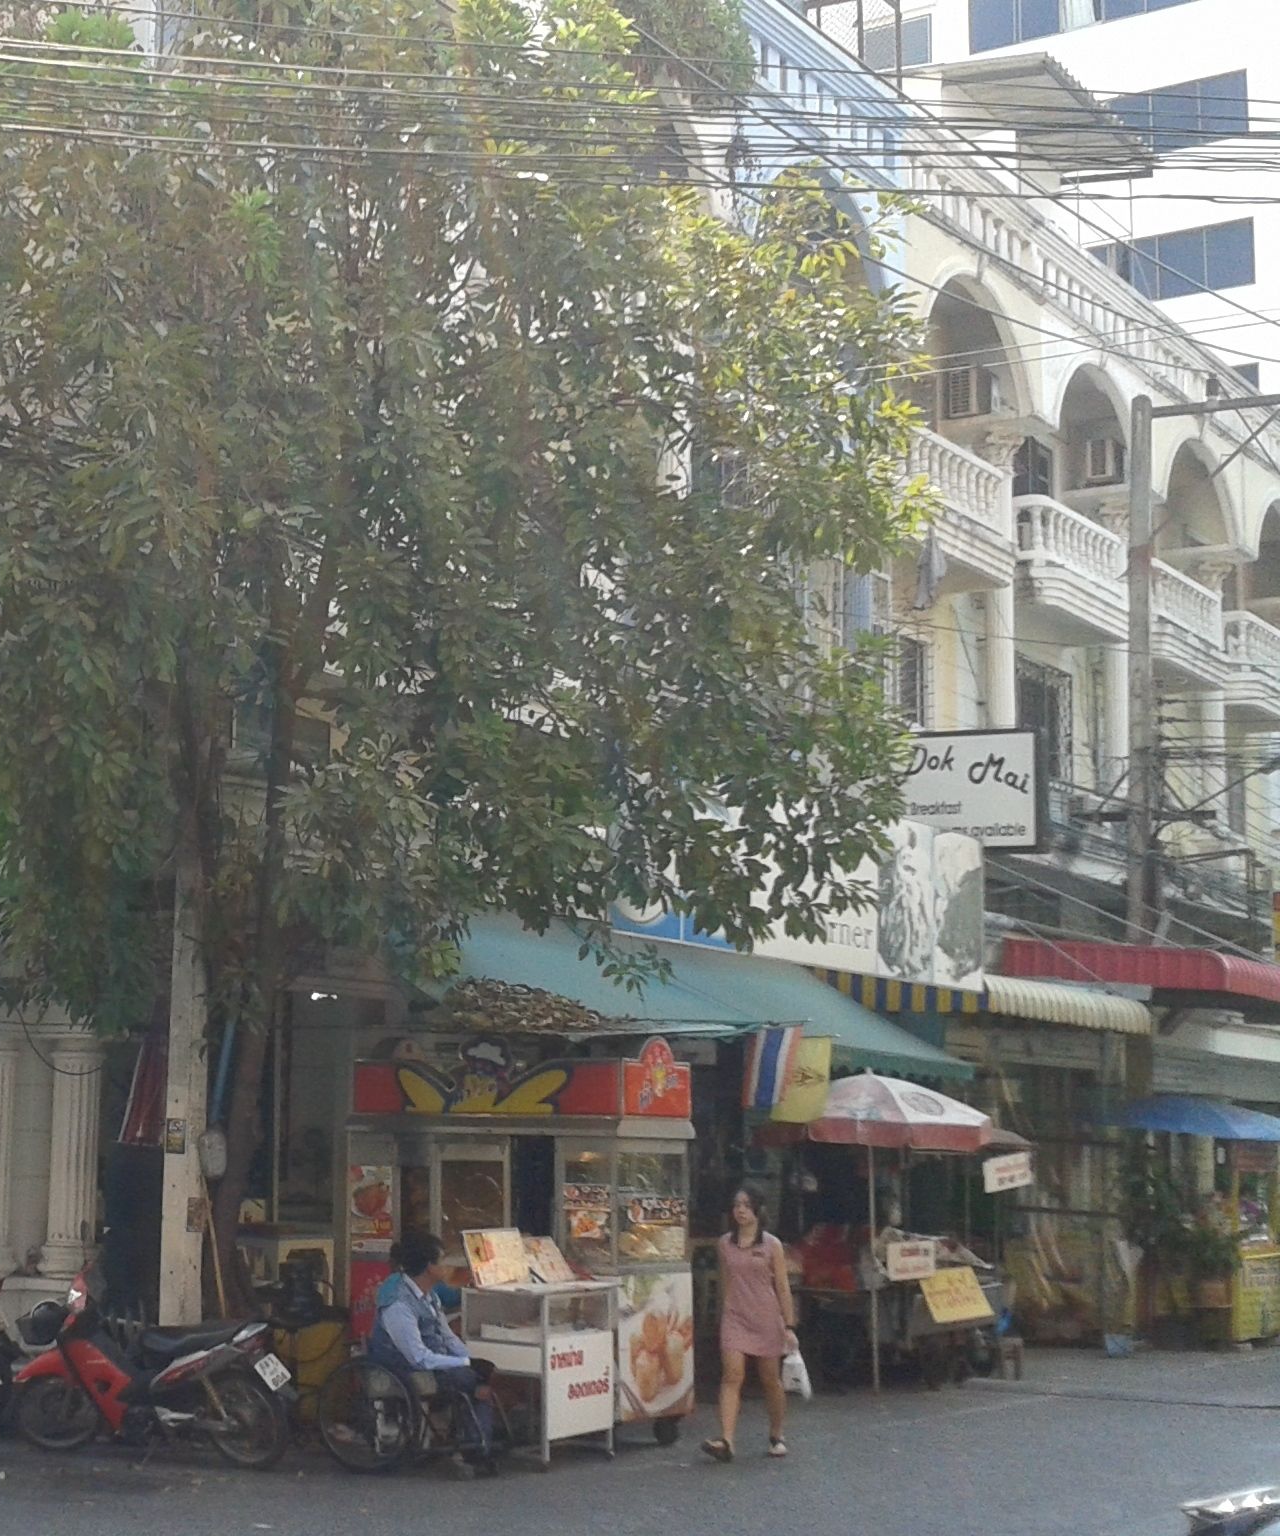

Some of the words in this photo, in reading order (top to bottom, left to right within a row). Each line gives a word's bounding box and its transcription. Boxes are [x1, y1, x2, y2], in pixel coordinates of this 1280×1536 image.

[893, 743, 954, 787] Dok
[968, 753, 1030, 794] Mai
[910, 801, 962, 816] Breakfast
[970, 823, 1027, 838] available
[827, 921, 874, 950] rner
